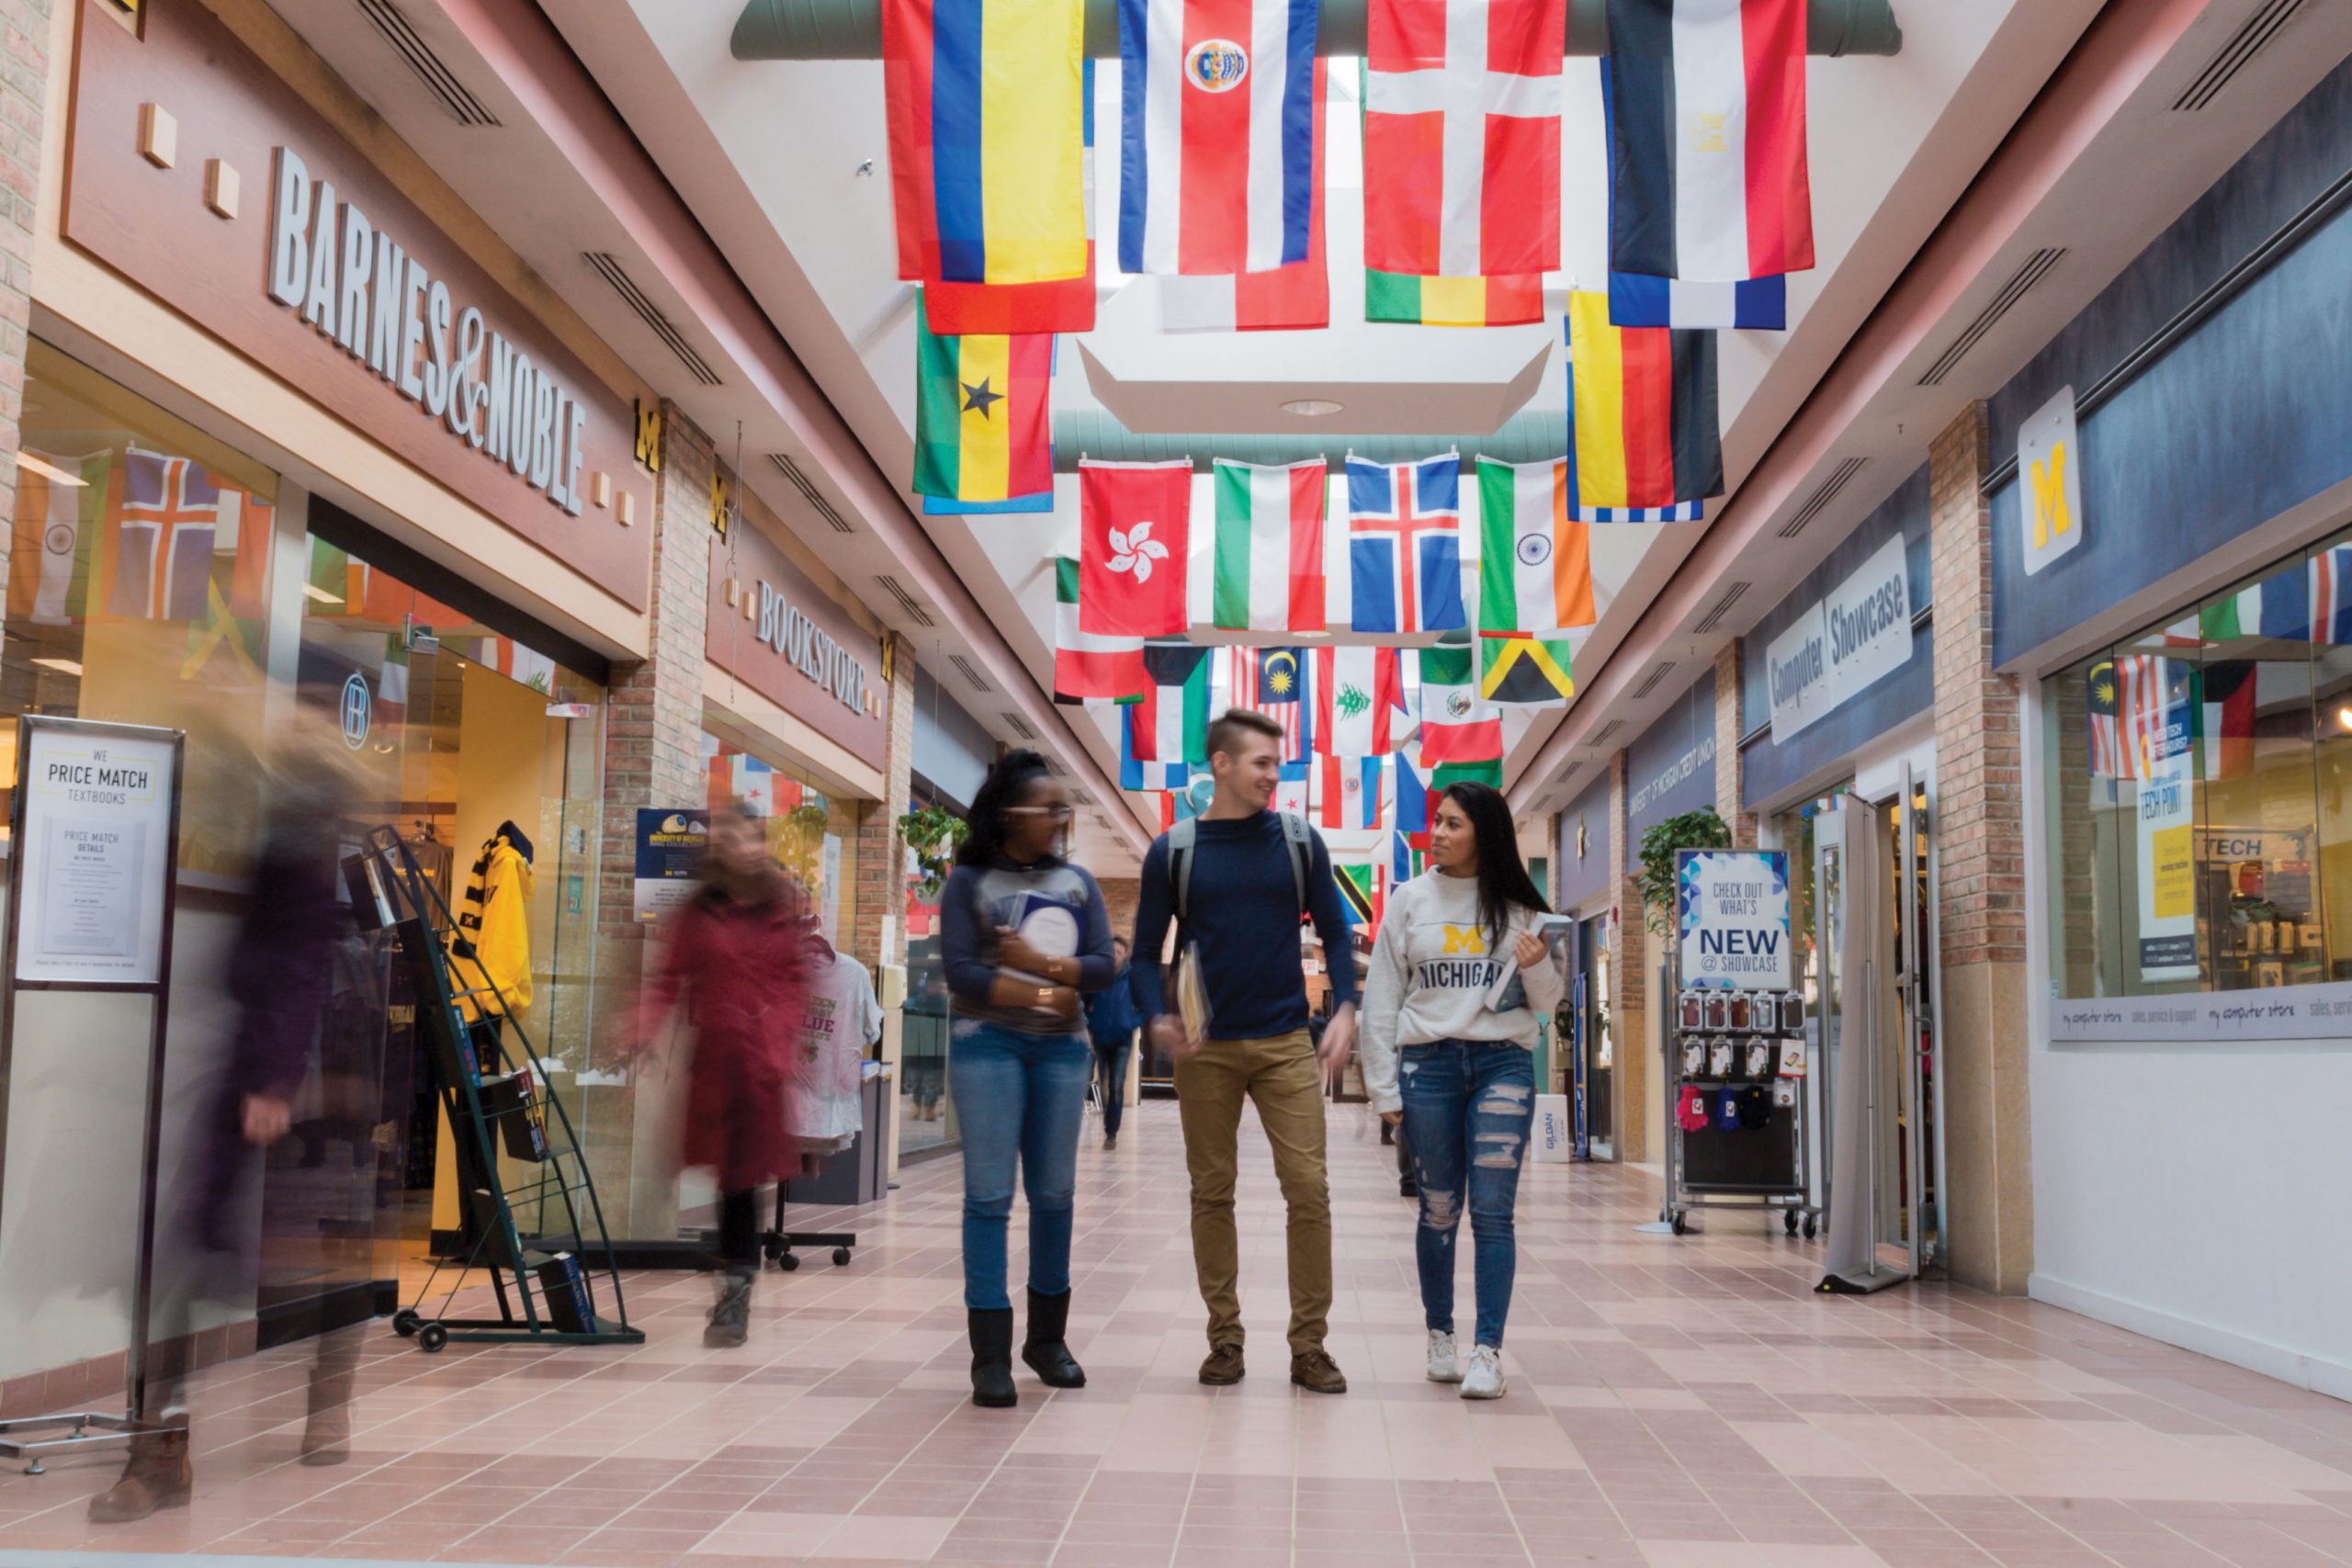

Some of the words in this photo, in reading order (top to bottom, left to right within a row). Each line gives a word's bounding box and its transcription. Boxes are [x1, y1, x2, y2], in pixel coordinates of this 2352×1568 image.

[269, 146, 450, 416] BARNES
[447, 307, 489, 448] &
[483, 331, 585, 517] NOBLE
[2030, 441, 2074, 551] M
[756, 580, 865, 716] BOOKSTORE
[1770, 637, 1824, 709] Computer
[1830, 573, 1904, 666] Showcase
[2168, 723, 2183, 736] TECH
[94, 750, 108, 762] WE
[1679, 748, 1697, 781] CREDIT
[49, 764, 93, 784] PRICE
[98, 768, 148, 789] MATCH
[68, 789, 126, 805] TEXTBOOKS
[2141, 788, 2161, 820] TECH
[2162, 784, 2181, 816] POINT
[64, 830, 89, 842] PRICE
[92, 833, 119, 843] MATCH
[2203, 839, 2262, 855] TECH
[77, 843, 104, 853] DETAILS
[1713, 882, 1742, 898] CHECK
[1745, 882, 1763, 898] OUT
[1720, 899, 1757, 916] WHAT'S
[1442, 924, 1486, 954] M
[1700, 929, 1780, 955] NEW
[1701, 955, 1717, 972] @
[1722, 956, 1778, 973] SHOWCASE
[800, 1014, 836, 1033] LUE
[2222, 1000, 2265, 1029] computer
[2268, 998, 2295, 1017] store
